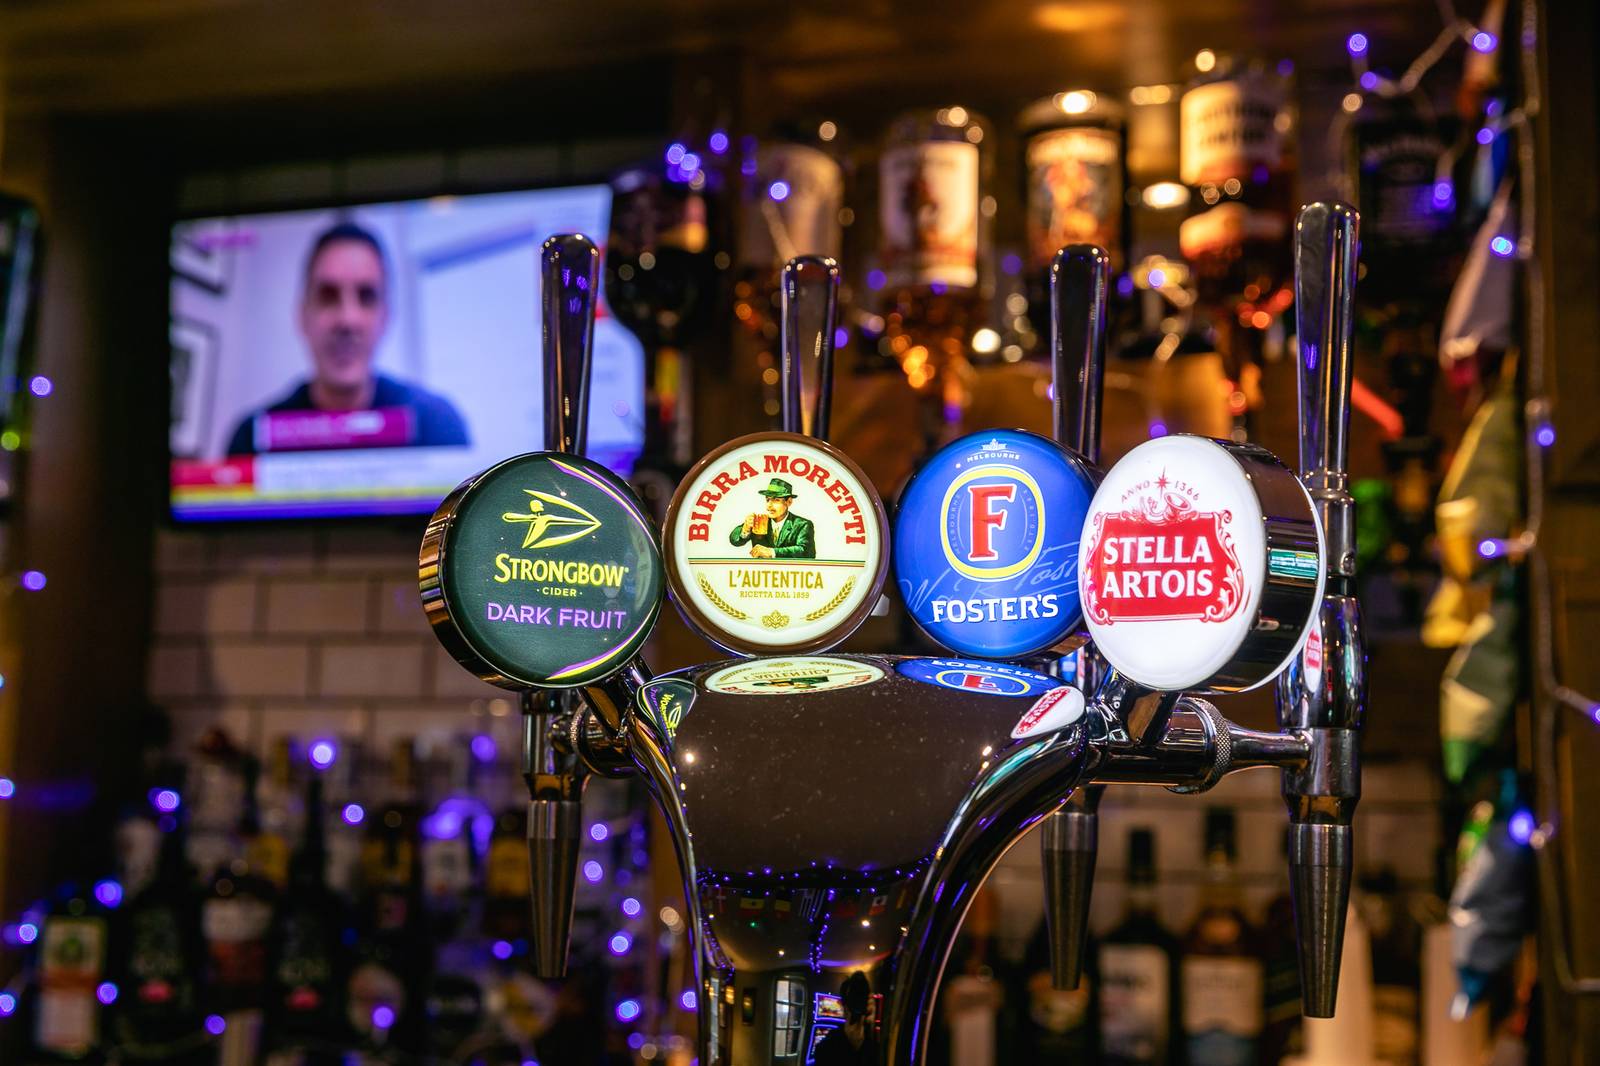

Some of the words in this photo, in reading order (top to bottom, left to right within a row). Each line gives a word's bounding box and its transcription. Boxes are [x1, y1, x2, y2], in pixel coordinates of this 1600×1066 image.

[967, 452, 1021, 462] MELBOURNE
[688, 460, 759, 542] BIRRA
[763, 455, 866, 545] MORETTI
[1121, 480, 1151, 503] ANNO
[1174, 480, 1200, 501] 1366
[968, 484, 1017, 561] F
[1103, 535, 1214, 565] STELLA
[494, 552, 625, 587] STRONGBOW
[729, 569, 824, 589] L'AUTENTICA
[1101, 569, 1214, 599] ARTOIS
[541, 586, 578, 597] CIDER
[739, 590, 773, 598] RICETTA
[775, 591, 791, 599] DAL
[486, 602, 552, 625] DARK
[558, 608, 627, 630] FRUIT
[931, 593, 1059, 623] FOSTER'S
